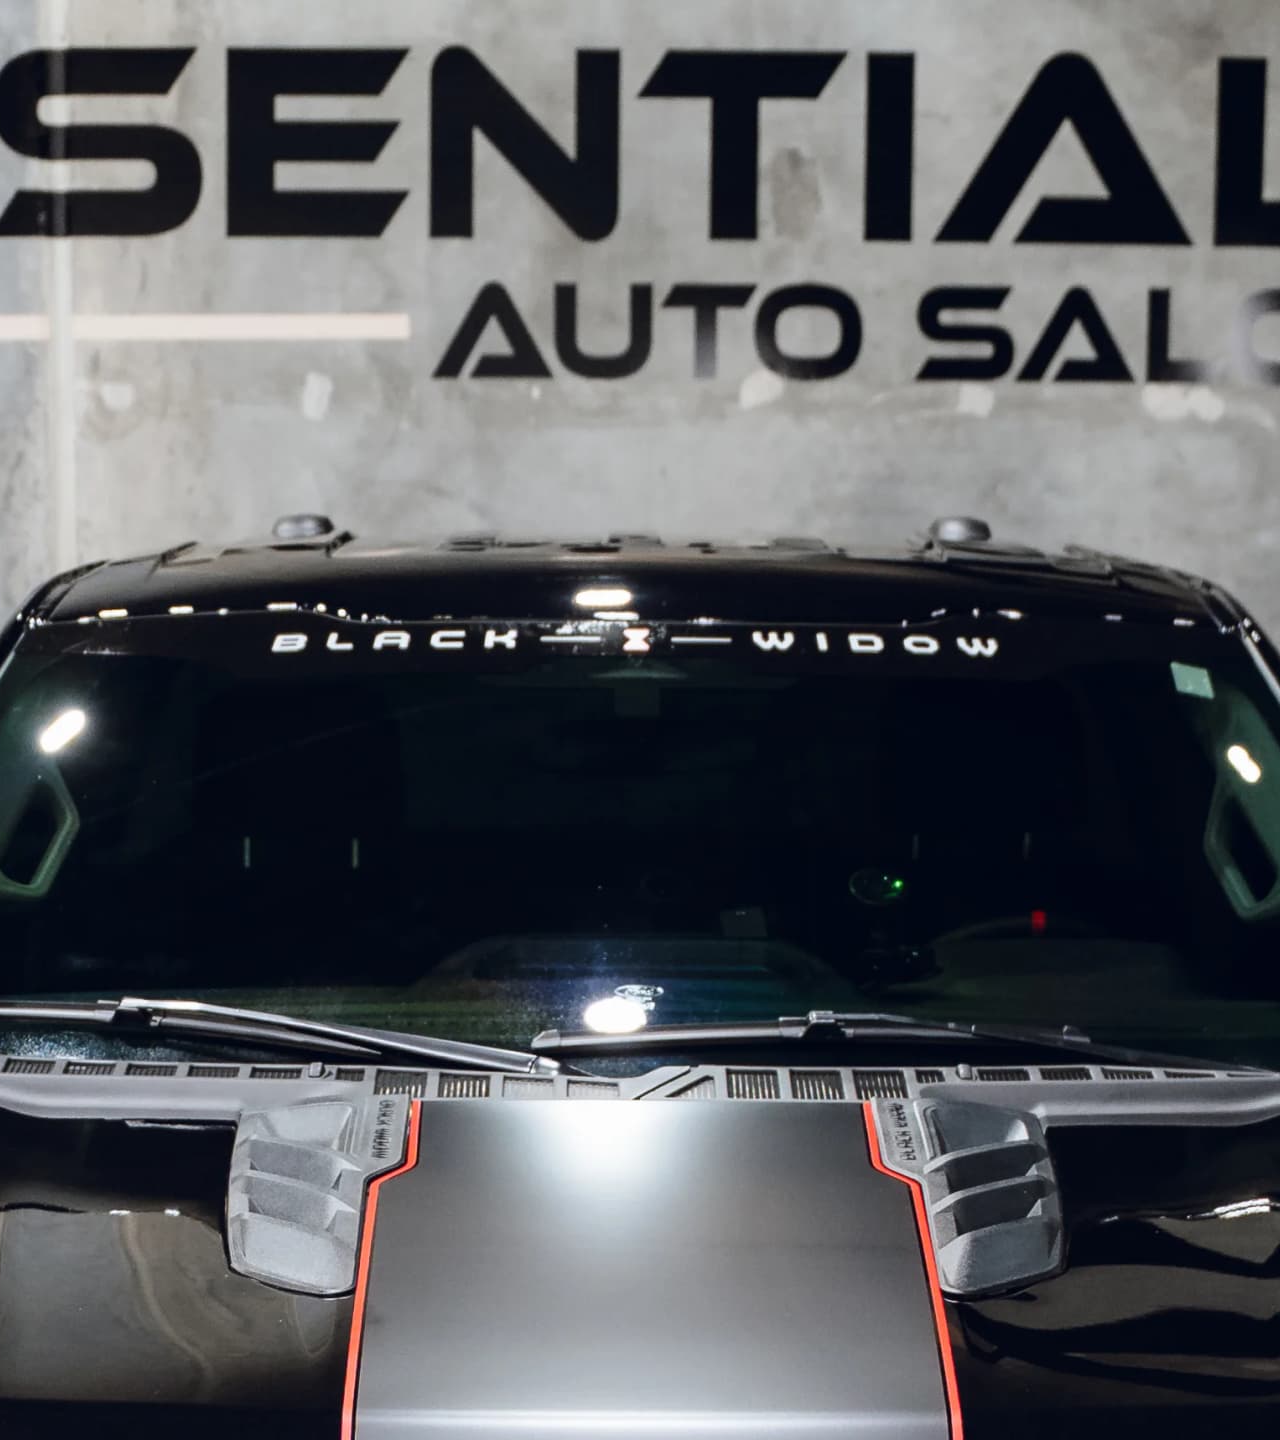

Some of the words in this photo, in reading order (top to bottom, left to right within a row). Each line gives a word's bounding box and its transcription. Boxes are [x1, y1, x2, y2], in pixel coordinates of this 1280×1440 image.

[432, 281, 863, 382] AUTO
[270, 629, 519, 653] BLACK
[751, 630, 1000, 658] WIDOW
